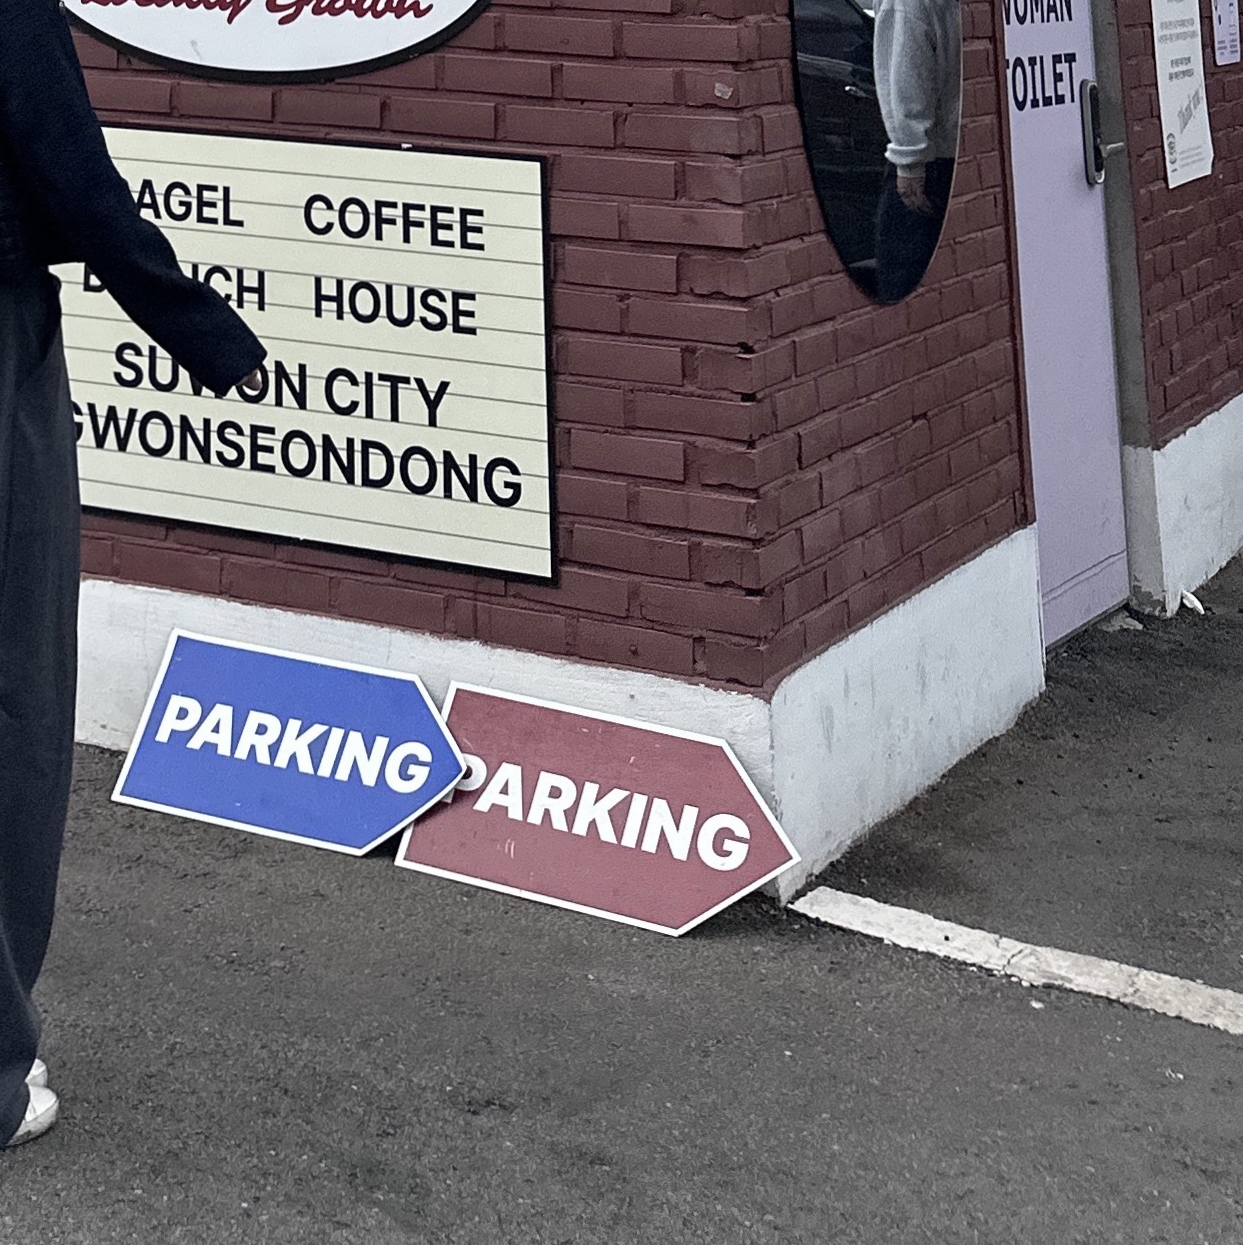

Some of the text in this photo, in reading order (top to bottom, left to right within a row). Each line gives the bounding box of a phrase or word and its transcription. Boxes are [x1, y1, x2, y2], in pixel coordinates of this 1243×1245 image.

[1004, 52, 1077, 112] OILET
[136, 178, 486, 252] AGEL COFFEE
[313, 275, 478, 336] HOUSE
[113, 341, 451, 428] SUON CITY
[154, 693, 432, 795] PARKING
